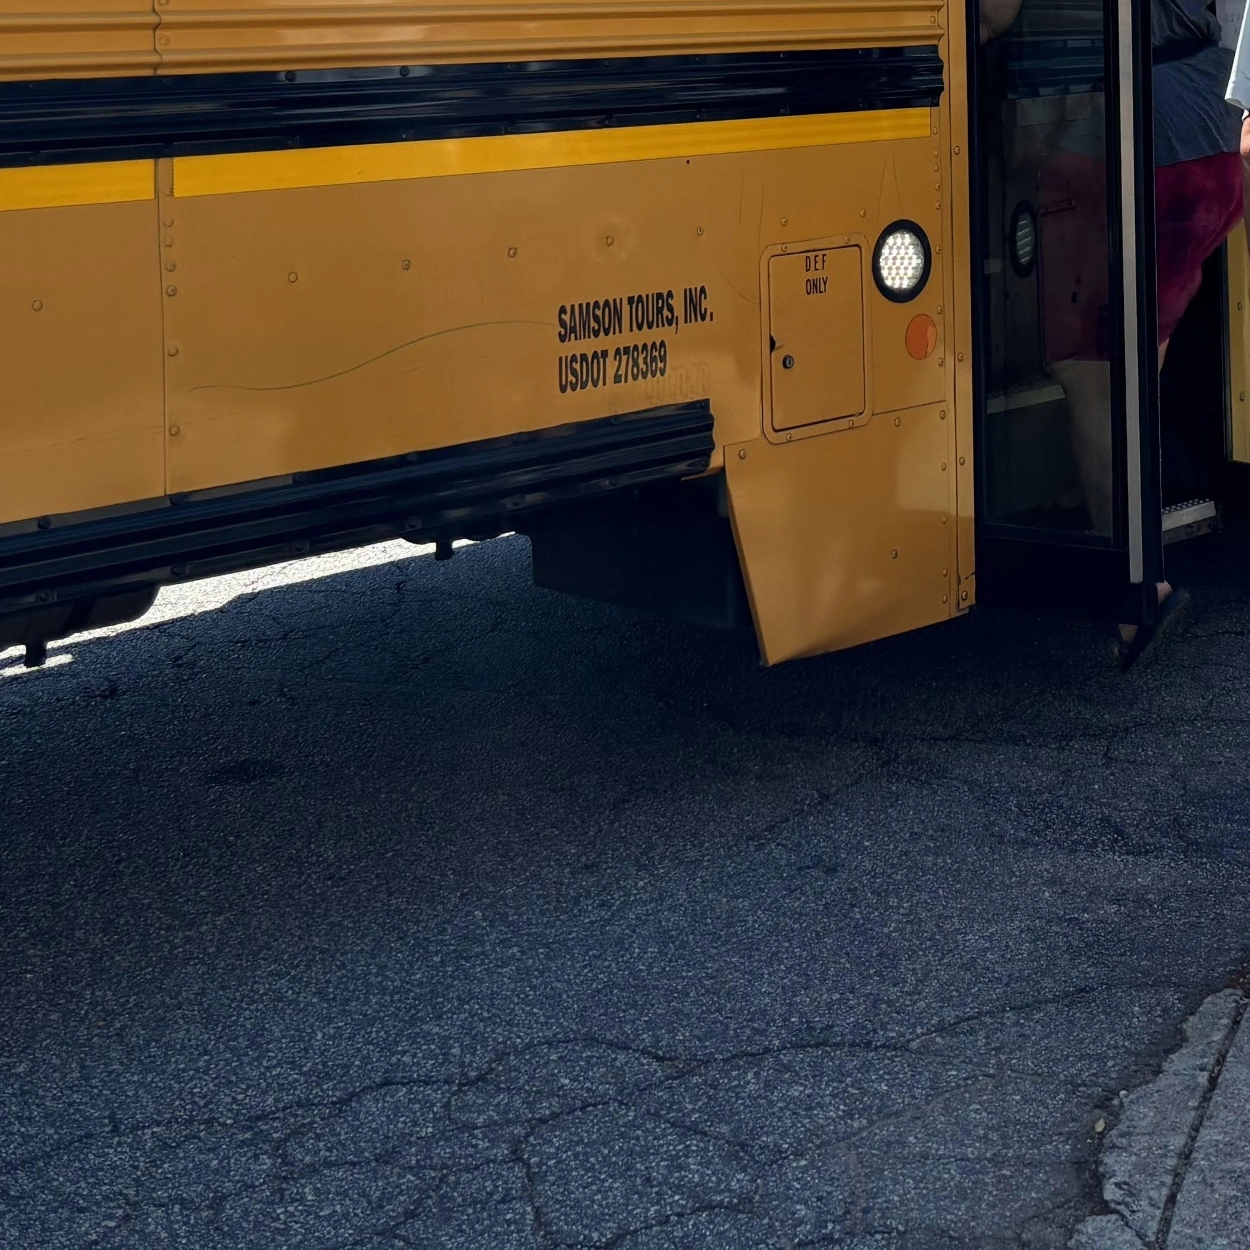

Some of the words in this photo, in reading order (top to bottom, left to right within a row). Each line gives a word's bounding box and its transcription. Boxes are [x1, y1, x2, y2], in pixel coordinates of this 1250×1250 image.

[805, 276, 828, 295] ONLY
[558, 297, 623, 343] SAMSON
[627, 289, 679, 335] TOURS,
[683, 285, 714, 324] INC.
[558, 349, 609, 394] USDOT
[613, 339, 667, 384] 278369
